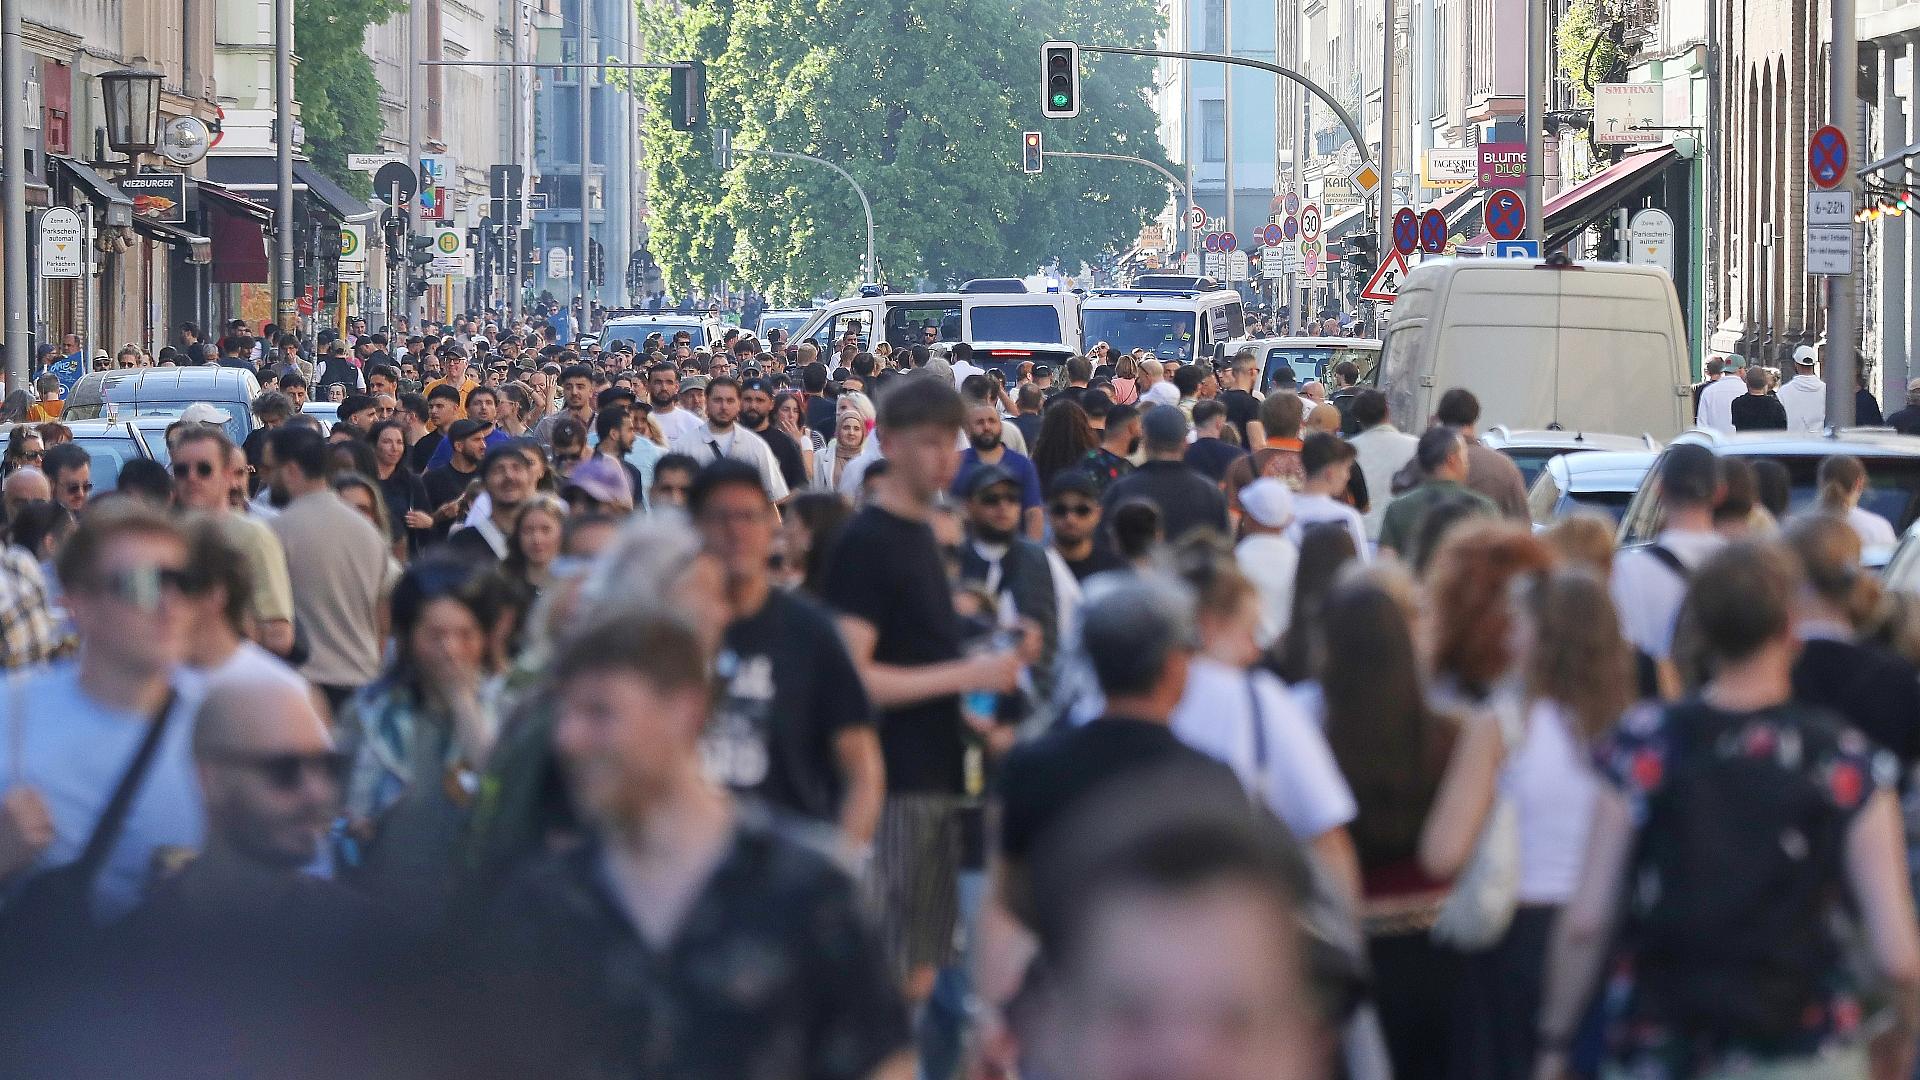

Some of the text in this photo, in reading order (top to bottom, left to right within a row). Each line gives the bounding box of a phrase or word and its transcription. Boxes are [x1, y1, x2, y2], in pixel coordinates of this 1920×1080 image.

[1605, 86, 1654, 95] SMYRNA
[122, 179, 174, 188] KIEZBURGER
[1815, 201, 1845, 214] 6-22h
[1304, 215, 1317, 232] 30
[42, 227, 80, 235] Parkschein-
